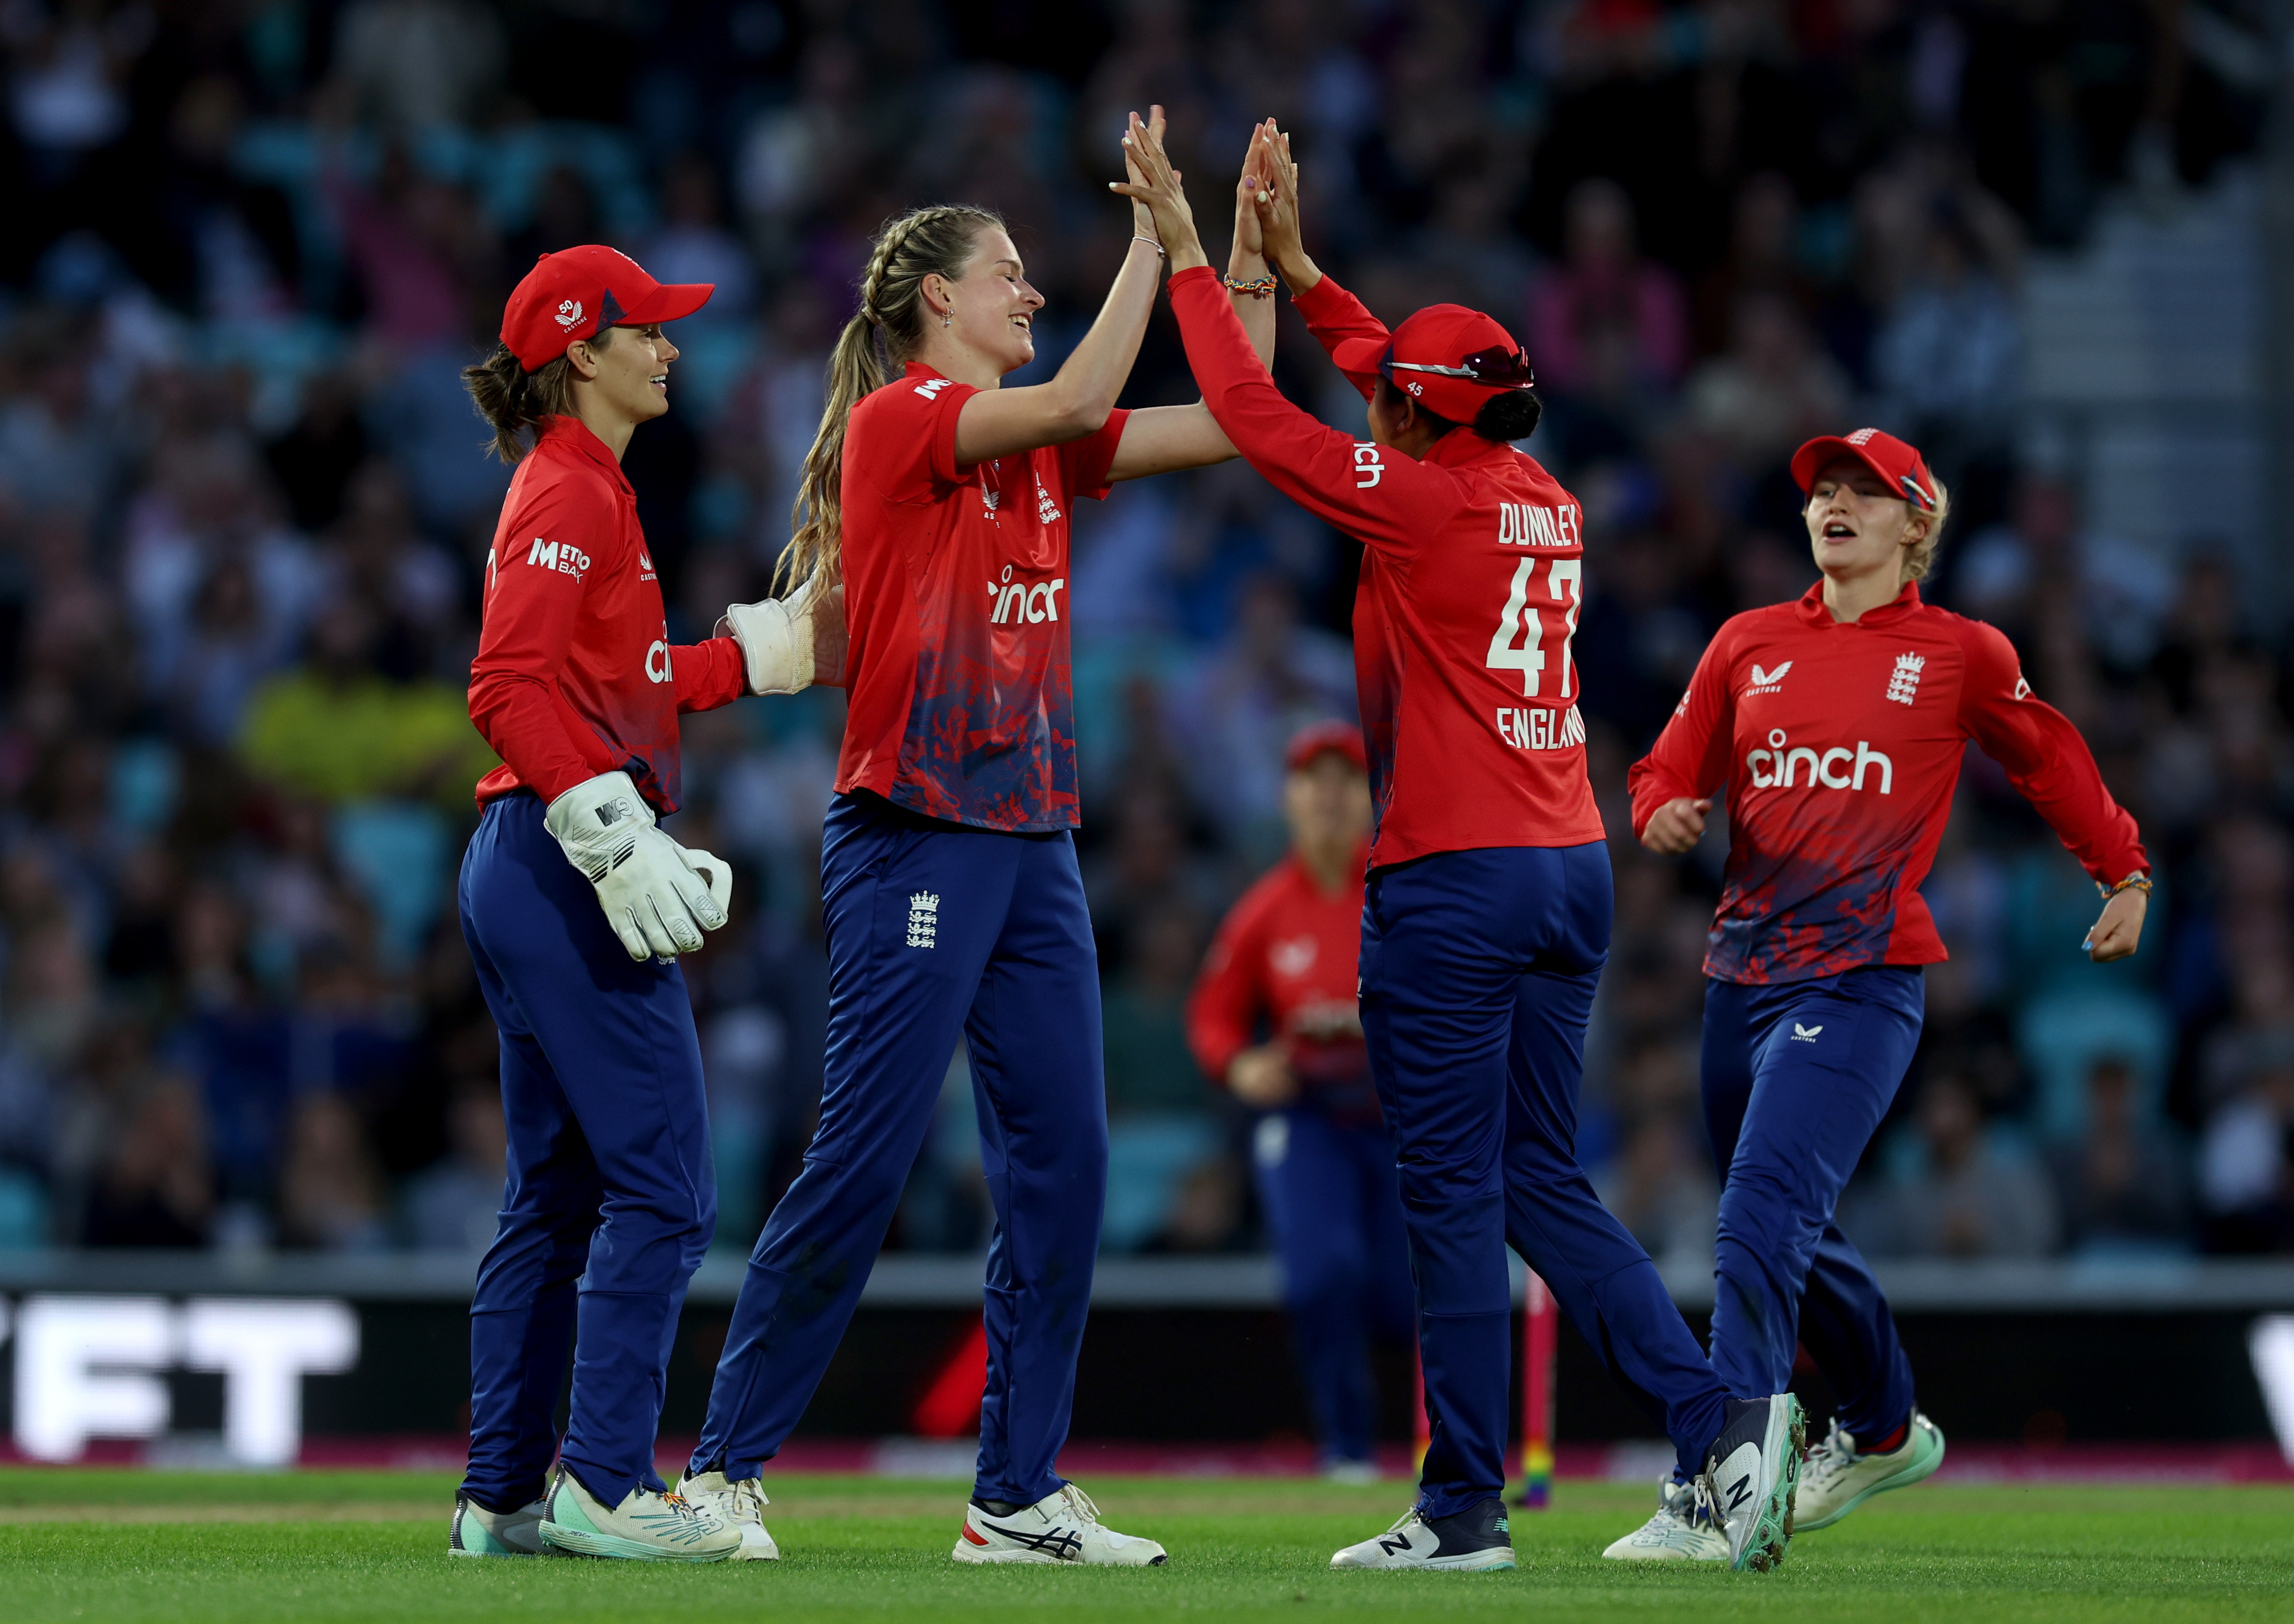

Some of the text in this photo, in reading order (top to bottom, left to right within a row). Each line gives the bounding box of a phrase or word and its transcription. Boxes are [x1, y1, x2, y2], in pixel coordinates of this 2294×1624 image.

[558, 299, 573, 314] 50
[564, 316, 588, 333] CASTORE
[1407, 382, 1423, 396] 45
[1499, 502, 1578, 546] DUNKLEY
[1485, 557, 1581, 698] 47
[1746, 728, 1893, 795] cinch
[594, 797, 634, 827] GM
